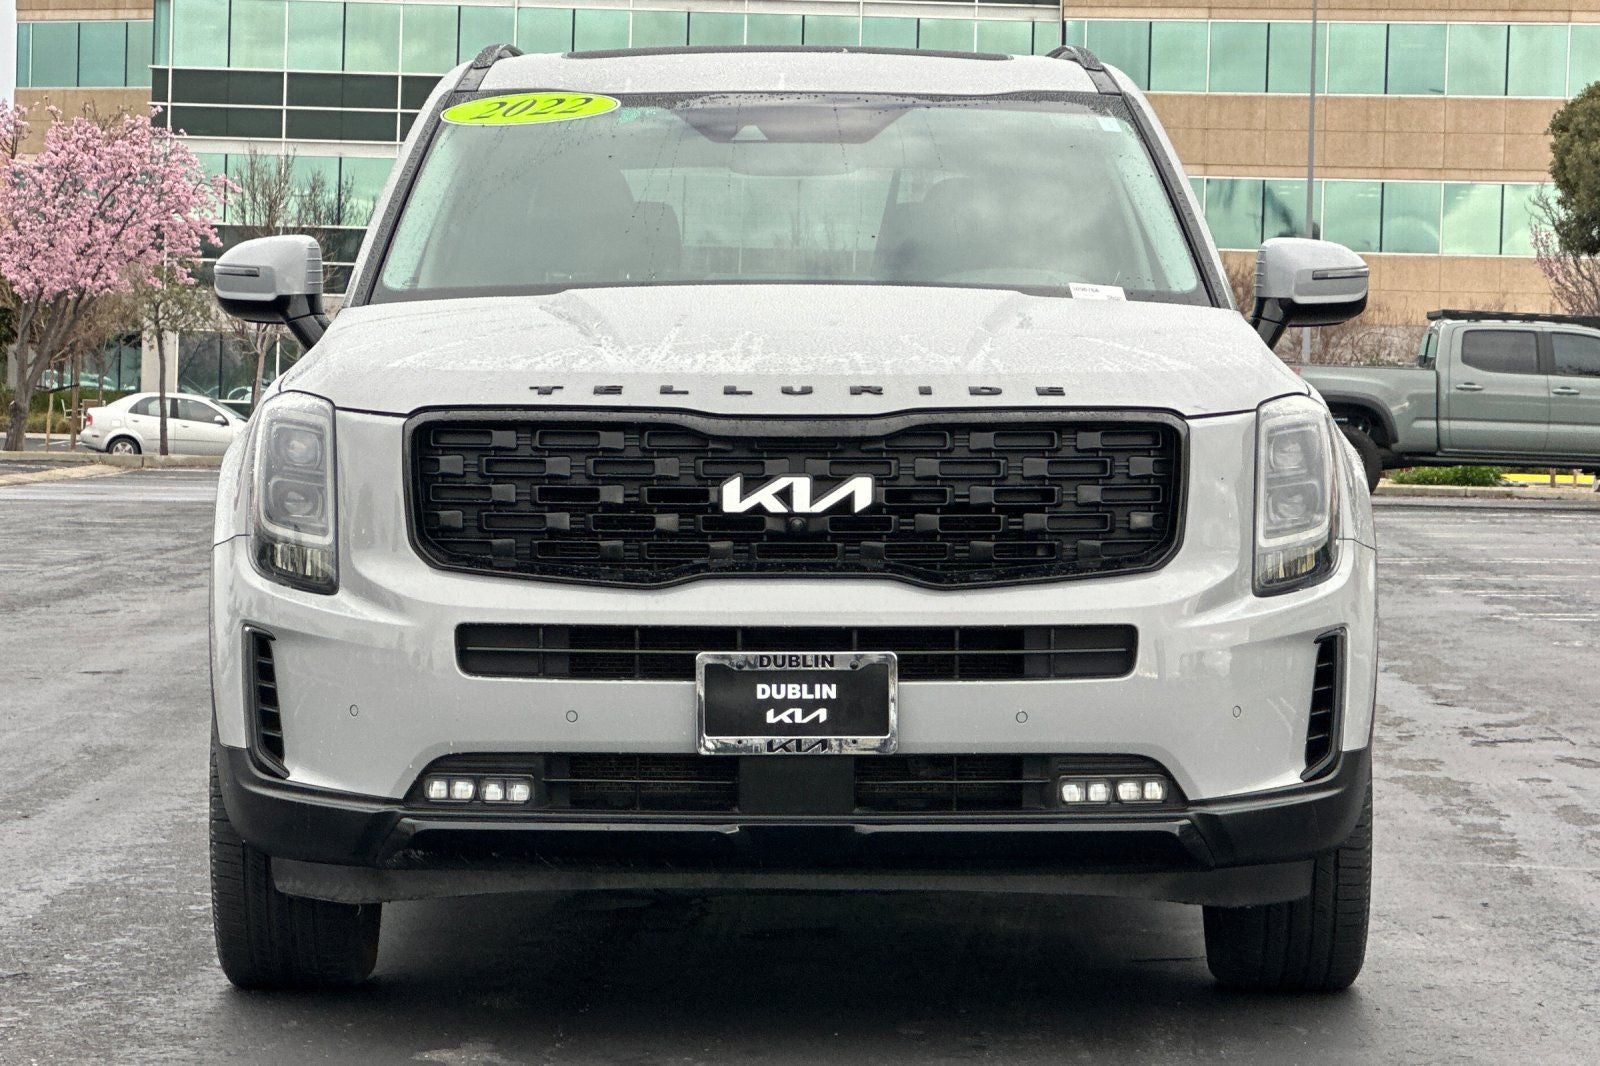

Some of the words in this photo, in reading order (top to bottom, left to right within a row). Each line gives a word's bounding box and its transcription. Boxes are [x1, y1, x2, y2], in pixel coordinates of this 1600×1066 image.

[469, 97, 593, 120] 2022
[529, 384, 1066, 396] TELLURIDE
[722, 476, 873, 513] KIA
[758, 654, 835, 668] DUBLIN
[756, 683, 837, 700] DUBLIN
[766, 707, 827, 723] KIA
[766, 738, 828, 752] KIA
